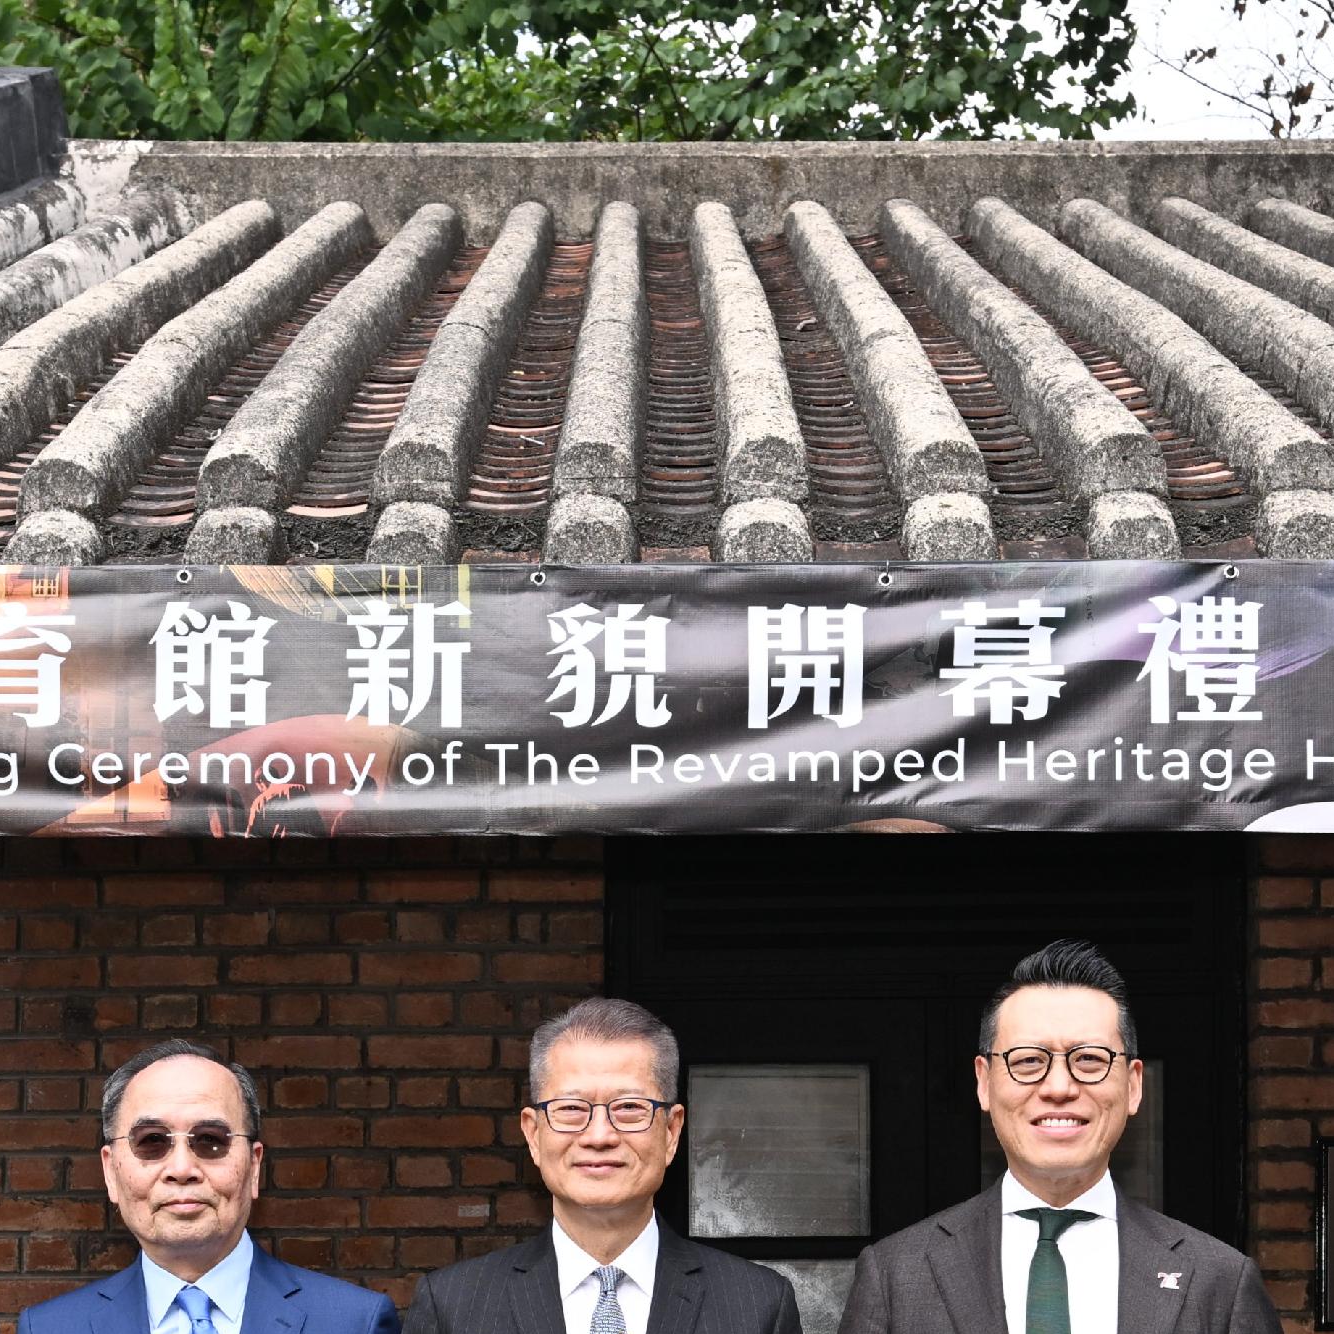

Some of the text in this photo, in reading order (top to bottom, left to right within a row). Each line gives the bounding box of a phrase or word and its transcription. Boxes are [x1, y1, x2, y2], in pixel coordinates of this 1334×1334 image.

[47, 742, 375, 795] Ceremony
[400, 739, 465, 786] of
[485, 742, 598, 785] The
[629, 737, 967, 788] Revamped
[997, 737, 1276, 792] Heritage
